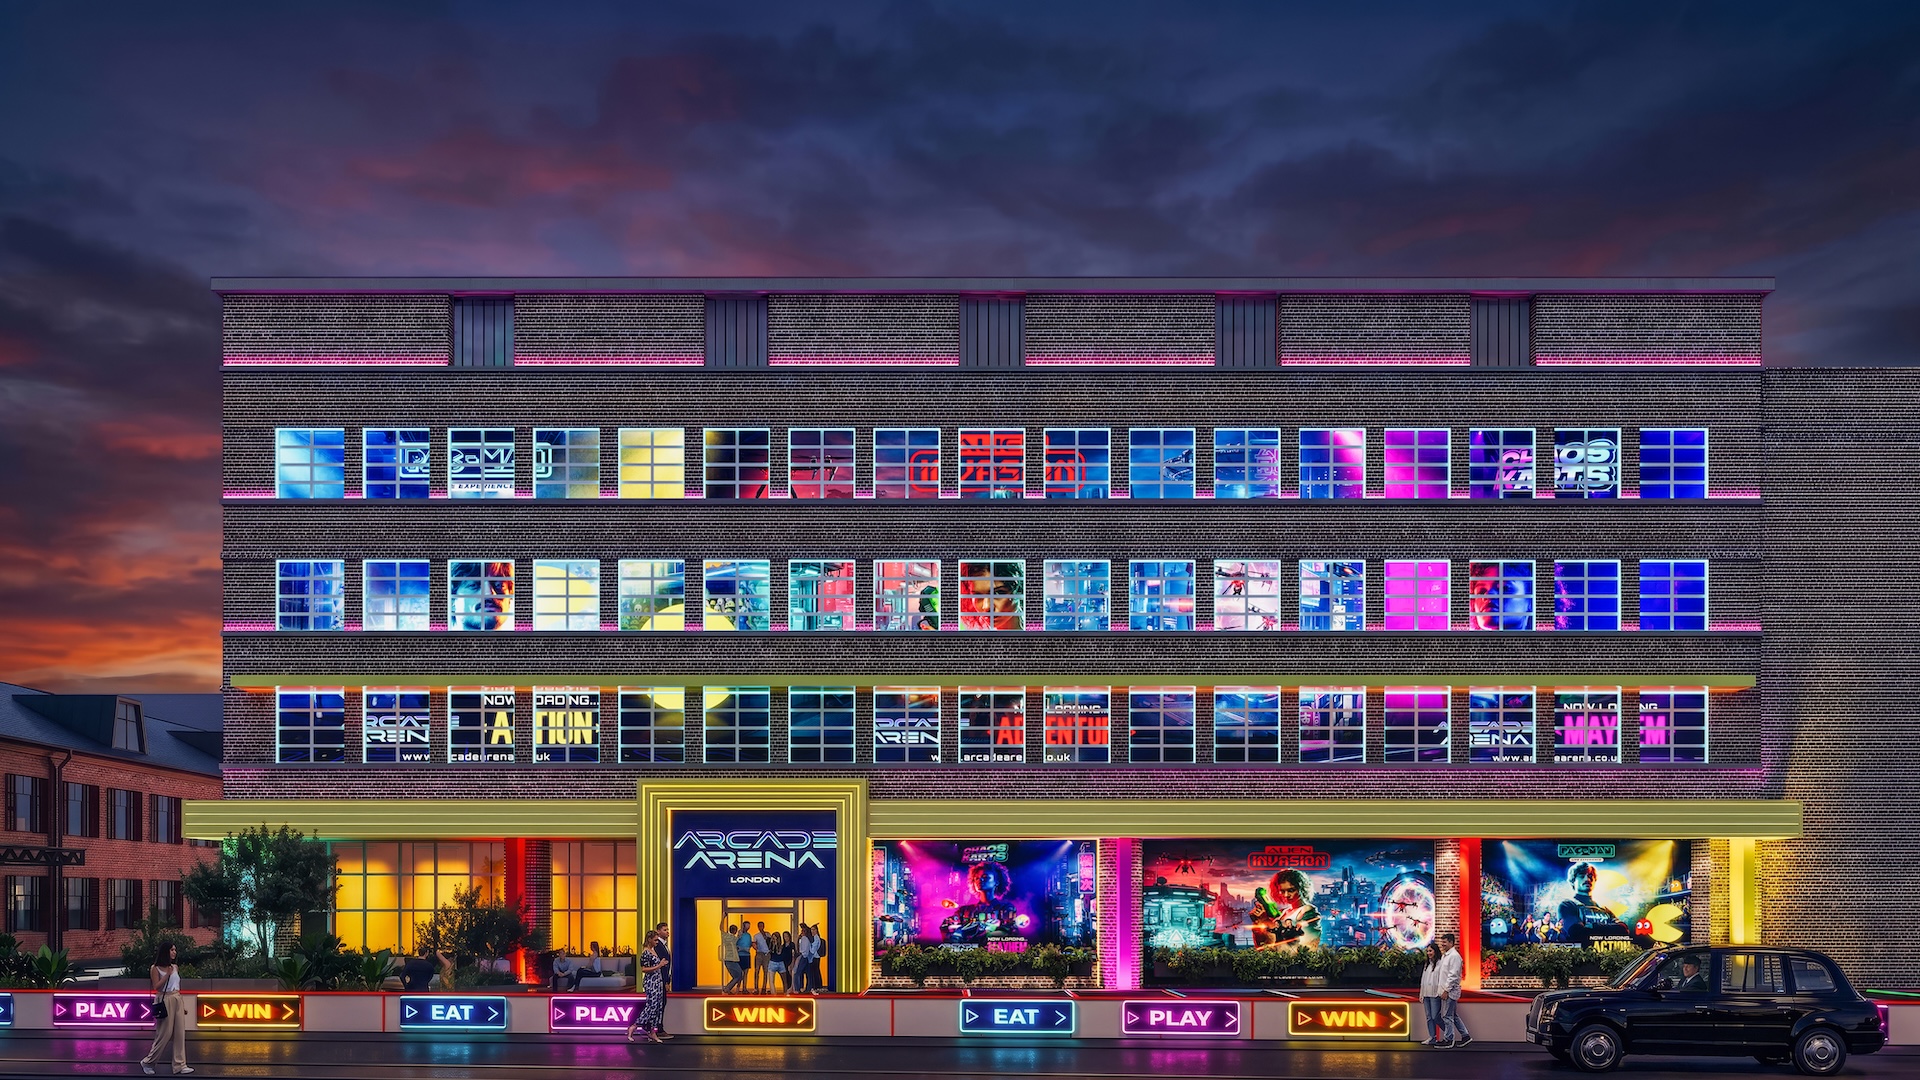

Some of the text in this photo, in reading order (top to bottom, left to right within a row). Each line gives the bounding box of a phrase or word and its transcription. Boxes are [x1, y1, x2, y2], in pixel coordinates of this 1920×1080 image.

[1501, 441, 1611, 469] CHOS
[1495, 465, 1610, 489] KATS
[484, 695, 514, 705] NOW
[491, 711, 592, 744] ATION
[997, 716, 1109, 745] ADENTU
[1564, 715, 1666, 745] MAYM
[674, 831, 837, 849] ARCADE
[962, 852, 1007, 861] KARTS
[963, 844, 1007, 853] CHAOS
[684, 851, 826, 869] ARENA
[1252, 856, 1326, 866] INVASION
[1594, 941, 1631, 952] ACTION
[75, 1002, 130, 1019] PLAY
[222, 1003, 272, 1019] WIN
[431, 1005, 474, 1021] EAT
[575, 1007, 633, 1022] PLAY
[733, 1007, 785, 1023] WIN
[994, 1009, 1040, 1025] EAT
[1150, 1010, 1212, 1026] PLAY
[1320, 1011, 1376, 1027] WIN
